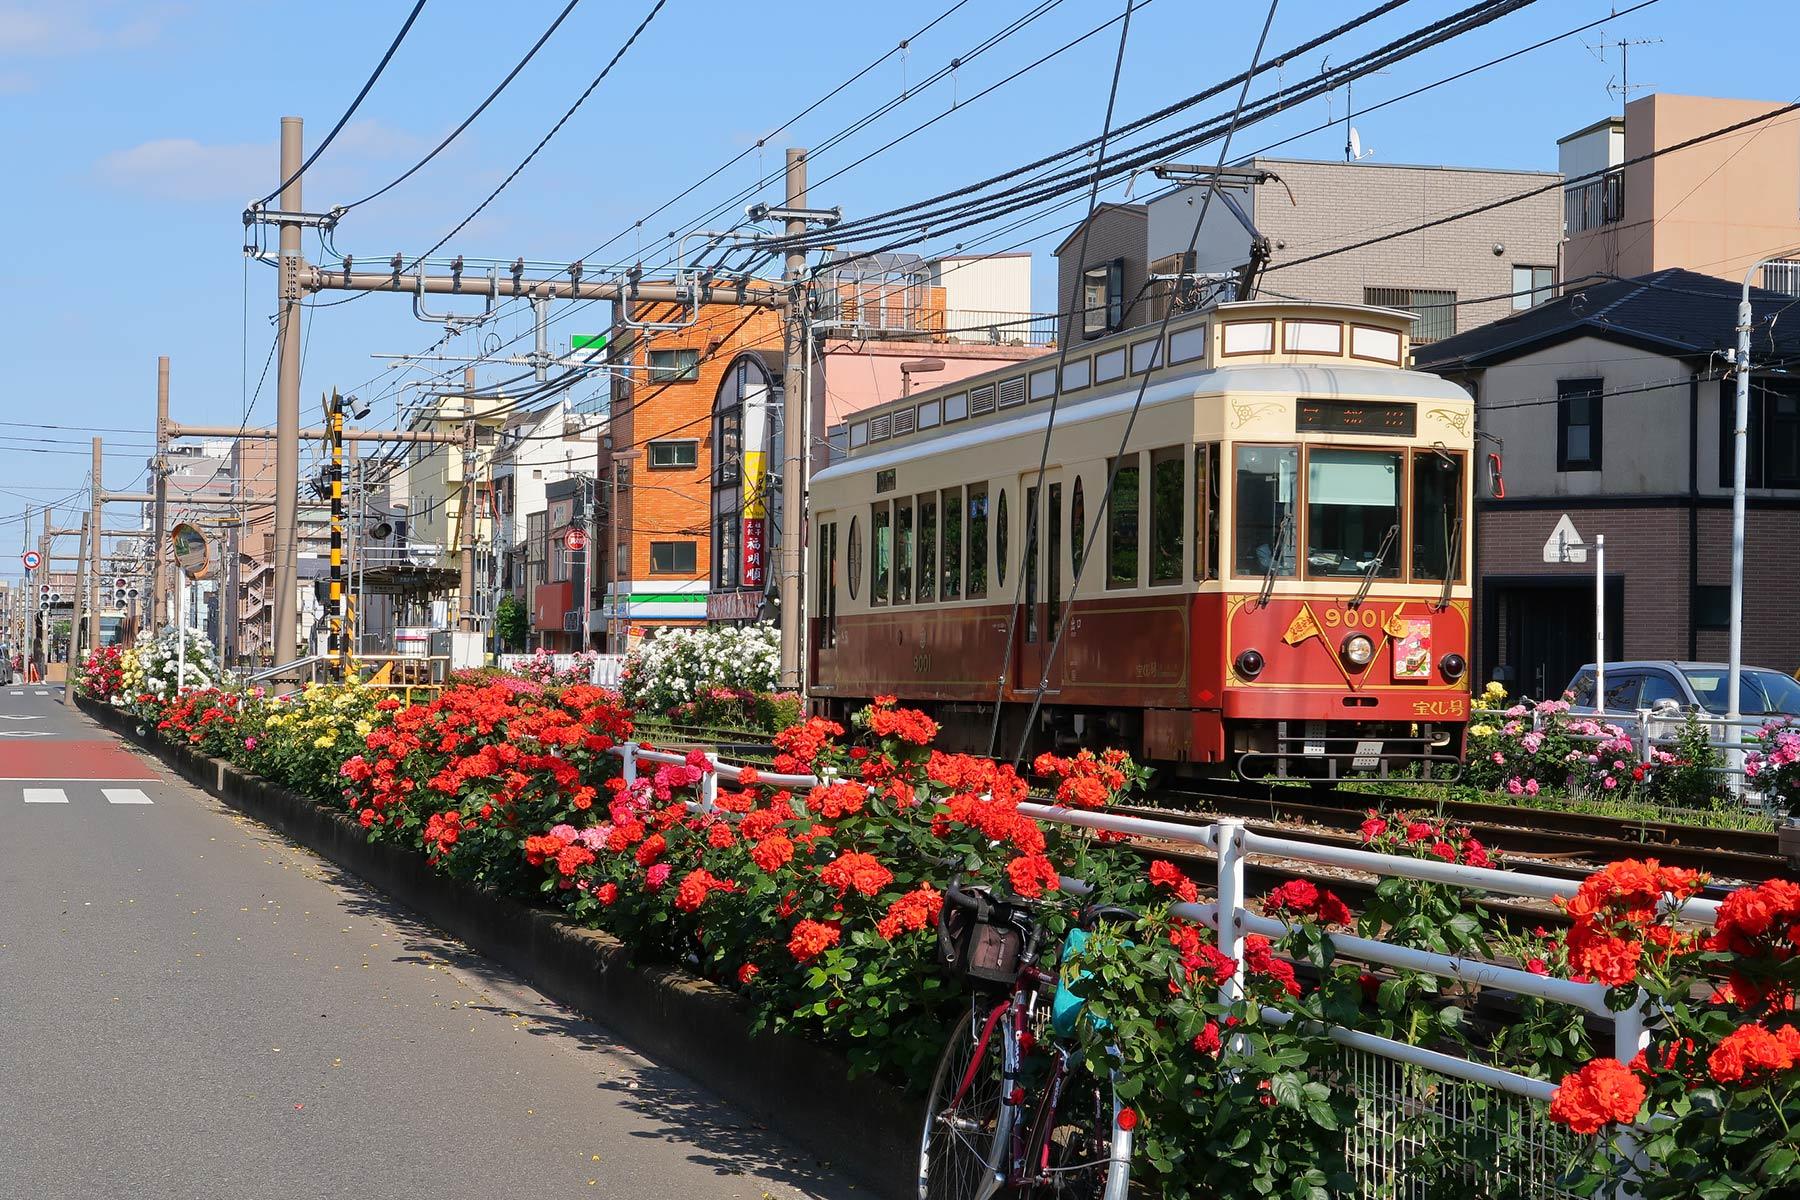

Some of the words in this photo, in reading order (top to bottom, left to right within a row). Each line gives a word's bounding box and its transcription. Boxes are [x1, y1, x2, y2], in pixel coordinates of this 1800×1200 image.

[1325, 608, 1386, 628] 9001
[914, 654, 931, 672] 9001
[1412, 700, 1464, 717] 宝くじ号
